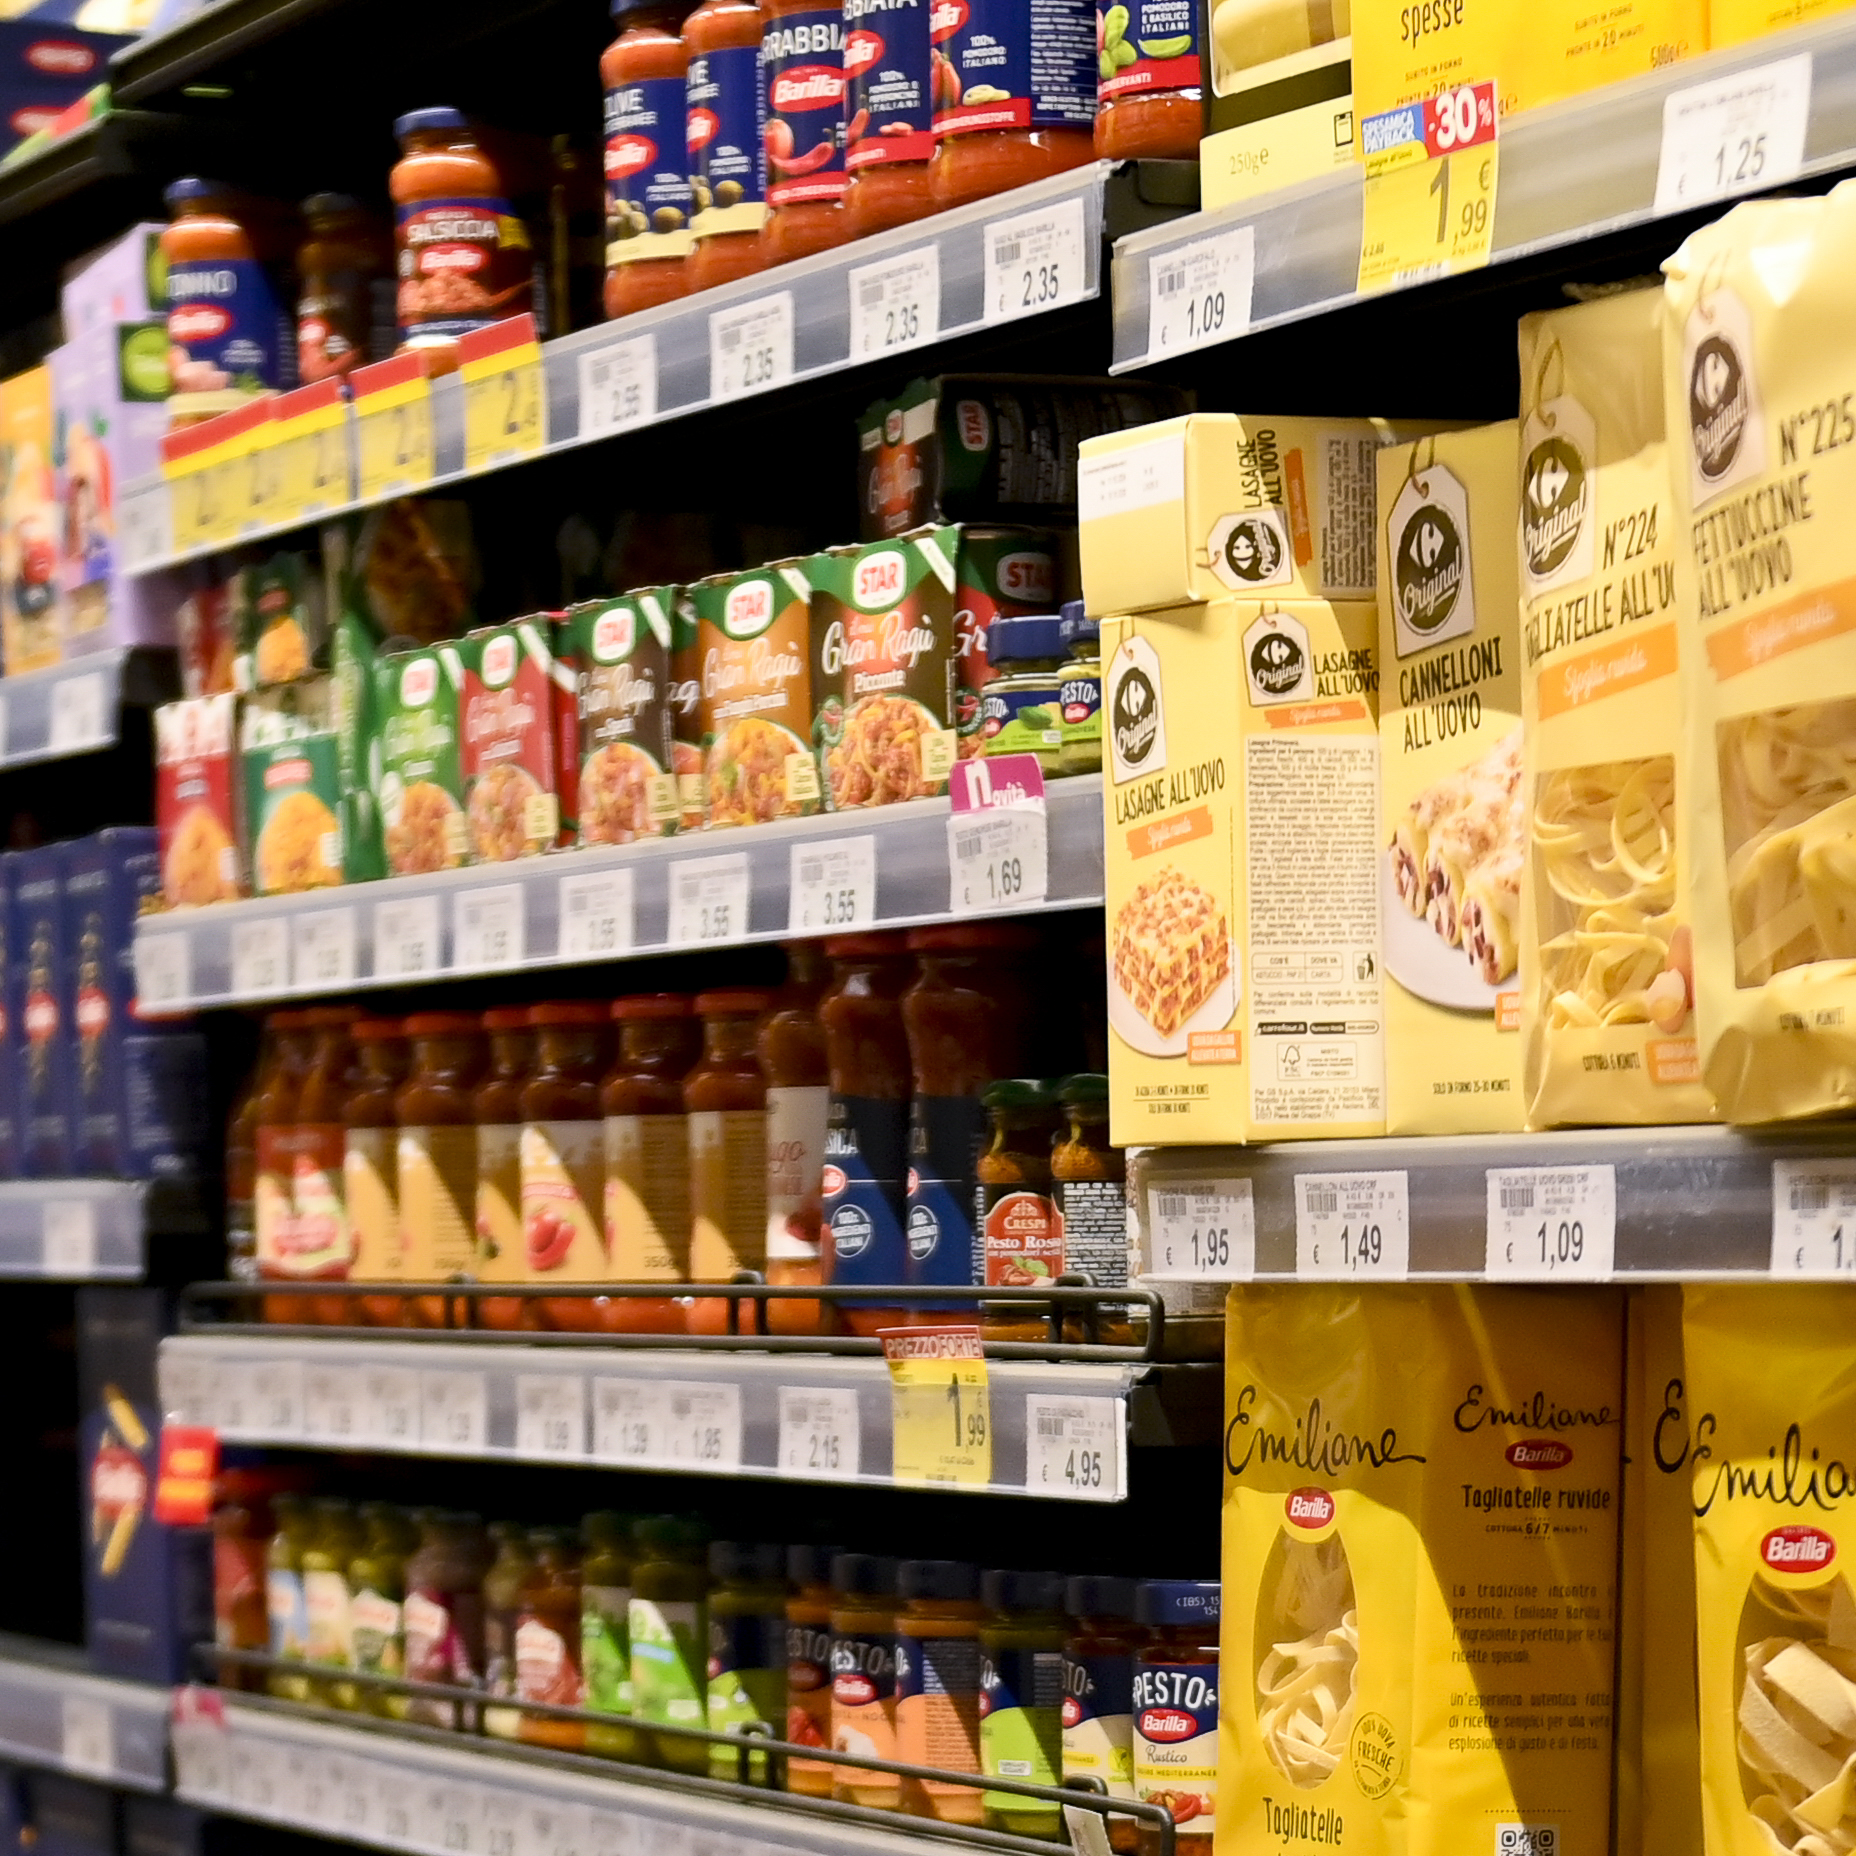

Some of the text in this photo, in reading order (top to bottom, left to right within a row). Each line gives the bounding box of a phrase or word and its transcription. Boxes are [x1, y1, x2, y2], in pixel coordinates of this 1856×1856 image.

[1141, 21, 1190, 33] ITALIANI
[1150, 10, 1190, 24] BASILICO
[1430, 156, 1452, 244] 1
[1188, 291, 1225, 345] 1,09
[1237, 438, 1262, 508] LASAGNE
[1692, 470, 1815, 567] FETTUCCINE
[860, 562, 898, 595] STAR
[1403, 560, 1462, 615] Original
[731, 590, 766, 623] STAR
[822, 610, 936, 675] Gran Ragù
[703, 637, 802, 699] Gran Ragù
[1256, 655, 1304, 689] Original
[1314, 648, 1373, 674] LASAGNE
[1400, 636, 1503, 708] CANNELLONI
[1117, 699, 1158, 752] Original
[1403, 691, 1482, 753] ALL'UOVO
[1115, 757, 1225, 825] LASAGNE ALL'UOVO
[986, 857, 1021, 902] 1,69
[987, 1235, 1020, 1249] Pesto
[1191, 1228, 1229, 1278] 1,95
[1341, 1223, 1382, 1281] 1,49
[1537, 1220, 1584, 1270] 1,09
[1454, 1385, 1620, 1433] Emiliane
[1225, 1385, 1427, 1477] Emiliane
[1065, 1448, 1102, 1491] 4,95
[1512, 1445, 1569, 1465] Barilla
[1290, 1496, 1332, 1519] Barilla
[1462, 1484, 1611, 1513] Tagliatelle ruvide
[1525, 1522, 1550, 1537] 6/7
[1766, 1535, 1832, 1562] Barilla
[1477, 1584, 1597, 1598] tradizione incontra
[1452, 1605, 1558, 1622] presente. Emiliane
[1520, 1627, 1565, 1643] perfetto
[1451, 1650, 1488, 1663] ricette
[1136, 1670, 1206, 1708] PESTO
[1143, 1714, 1189, 1733] Barilla
[1449, 1714, 1563, 1731] di ricette per
[1145, 1744, 1189, 1764] Rustico
[1357, 1739, 1395, 1773] FRESCHE
[1449, 1736, 1547, 1753] esplosione gusto
[1262, 1796, 1344, 1846] Tagliatelle
